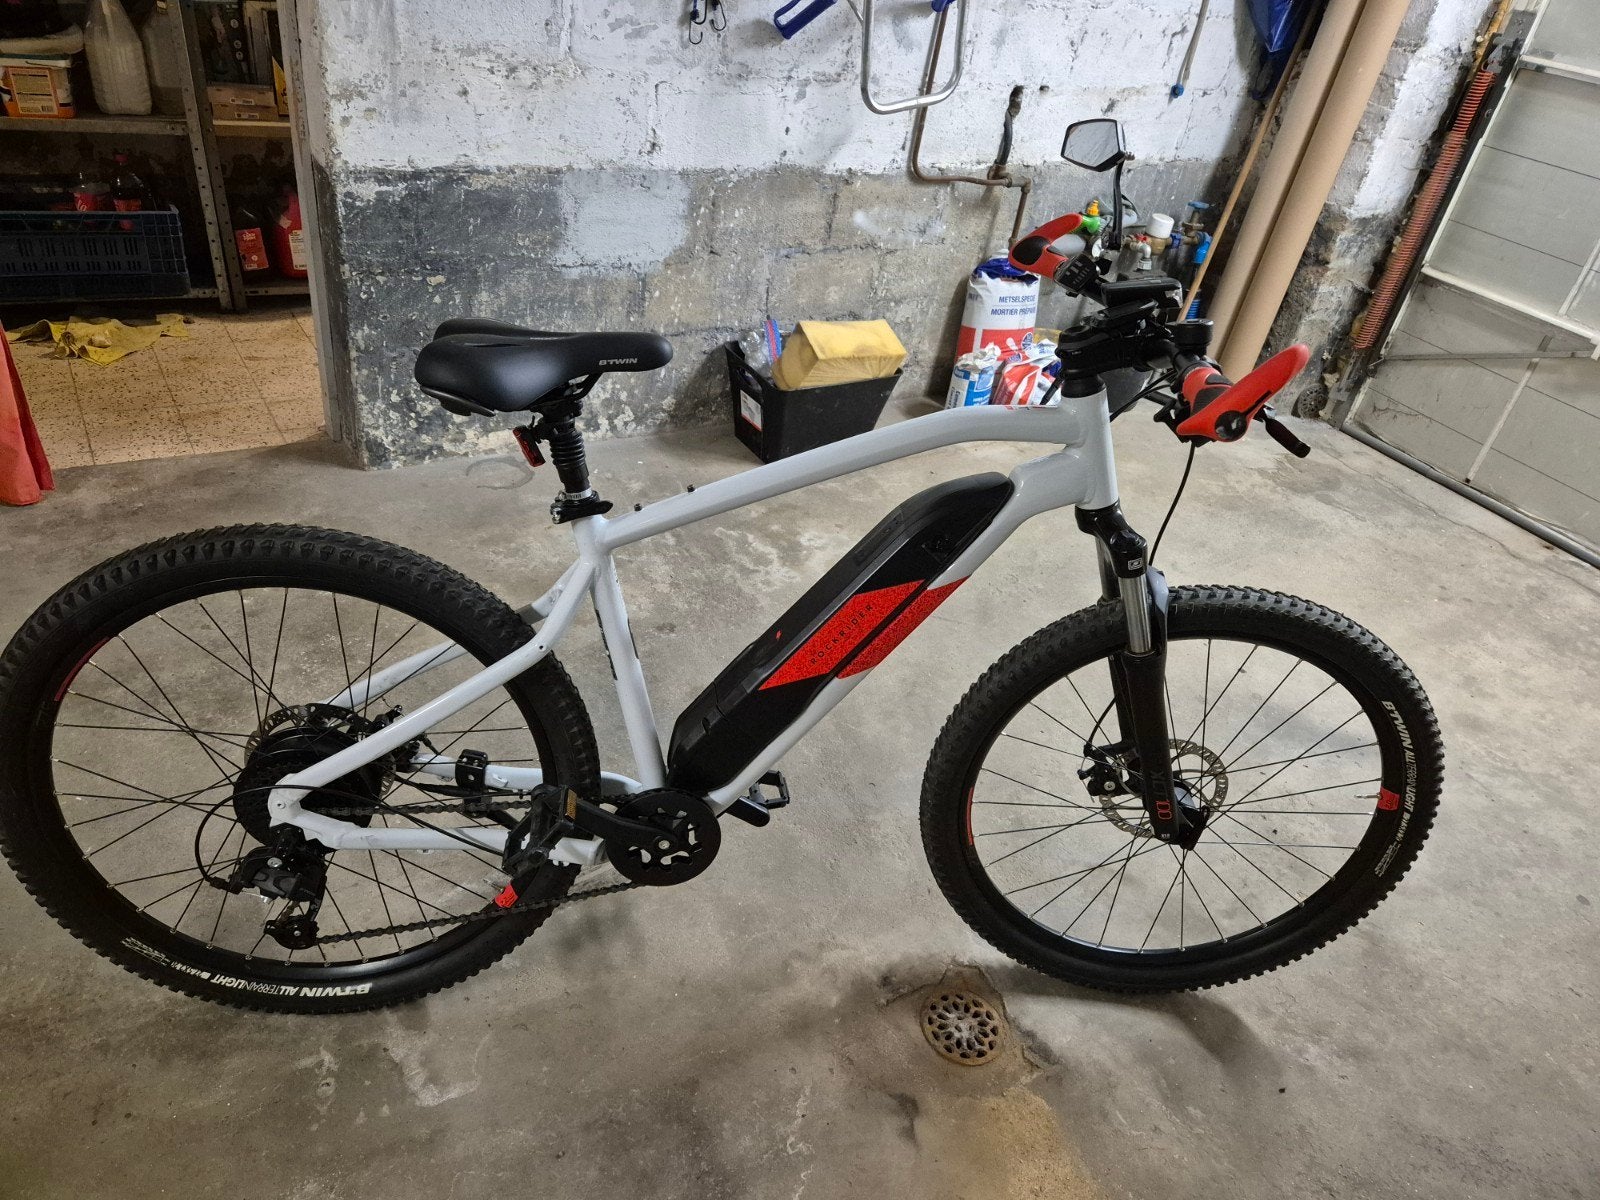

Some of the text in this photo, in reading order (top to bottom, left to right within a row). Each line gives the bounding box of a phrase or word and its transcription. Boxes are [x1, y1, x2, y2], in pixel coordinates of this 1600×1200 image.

[990, 308, 1019, 316] MORTIER
[598, 358, 638, 366] BTWIN
[810, 604, 873, 666] ROCKRIDER
[1381, 701, 1414, 749] BTWIN
